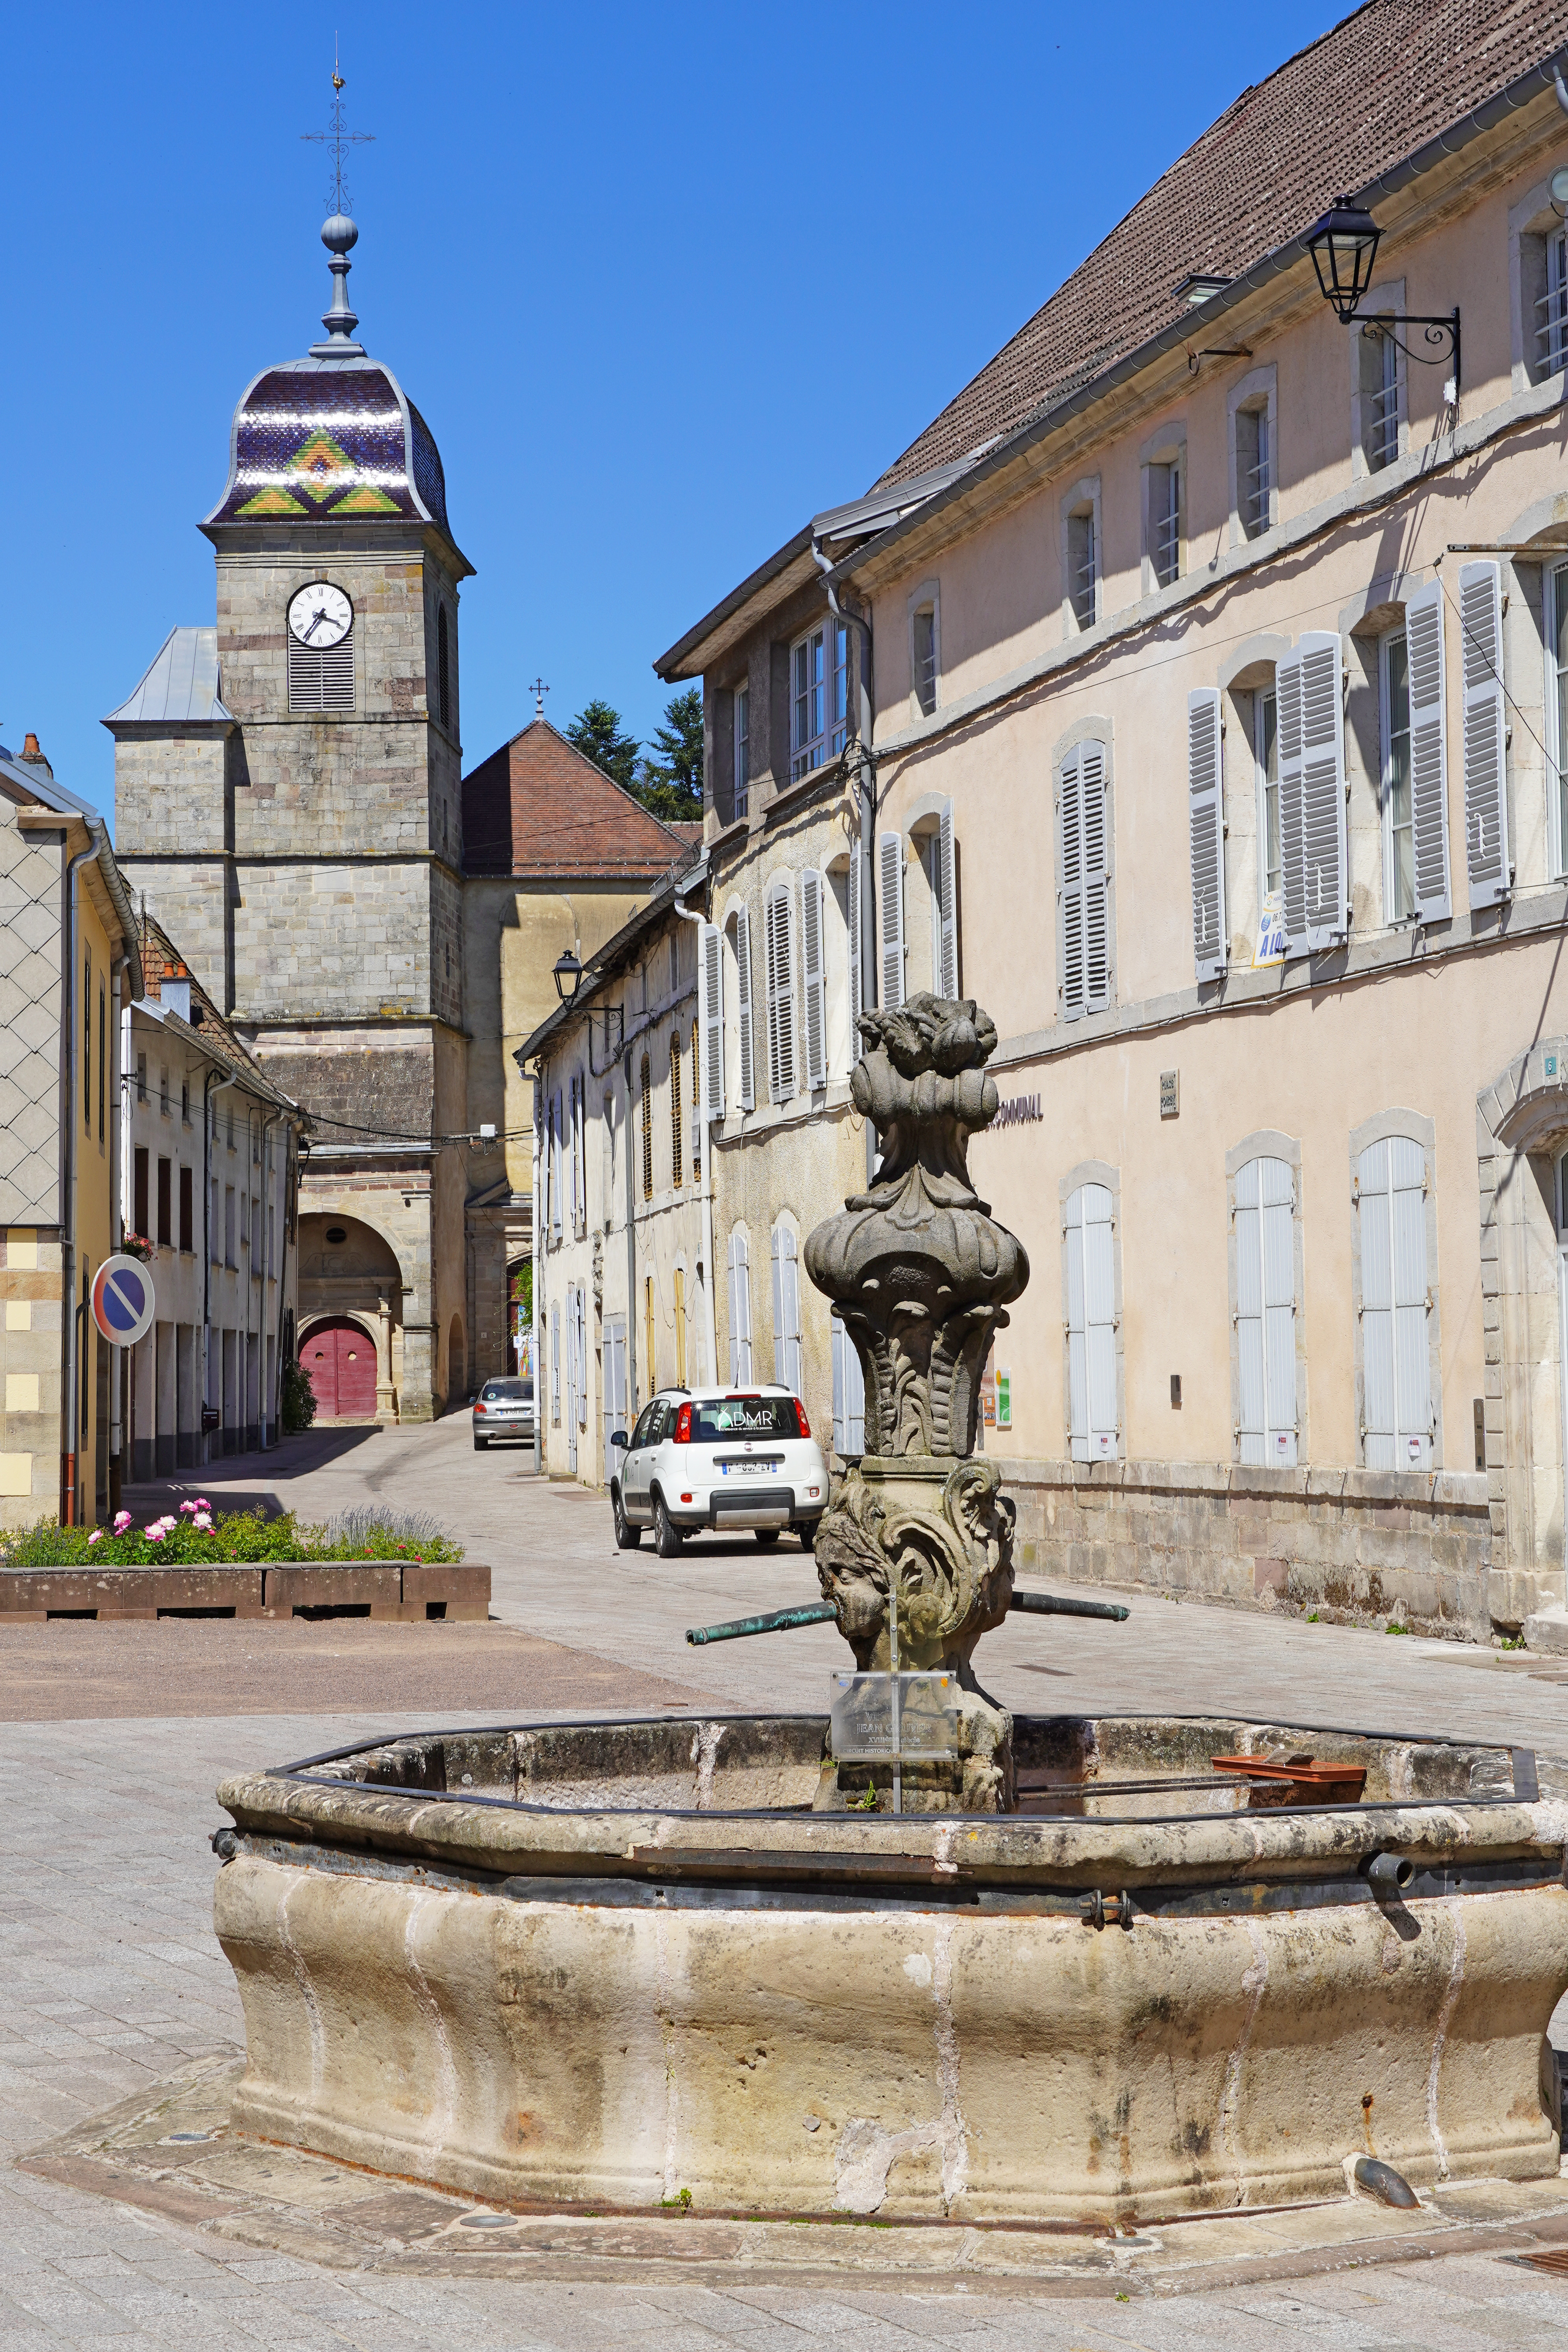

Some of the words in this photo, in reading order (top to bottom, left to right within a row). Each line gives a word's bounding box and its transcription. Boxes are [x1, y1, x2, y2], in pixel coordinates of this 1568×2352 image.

[1272, 912, 1283, 922] 06.7
[1259, 935, 1269, 957] A
[1269, 931, 1283, 956] LO
[1548, 1061, 1552, 1072] 6
[987, 1093, 1044, 1126] COMMUNAL
[718, 1406, 772, 1432] ADMR
[857, 1723, 882, 1734] JEAN
